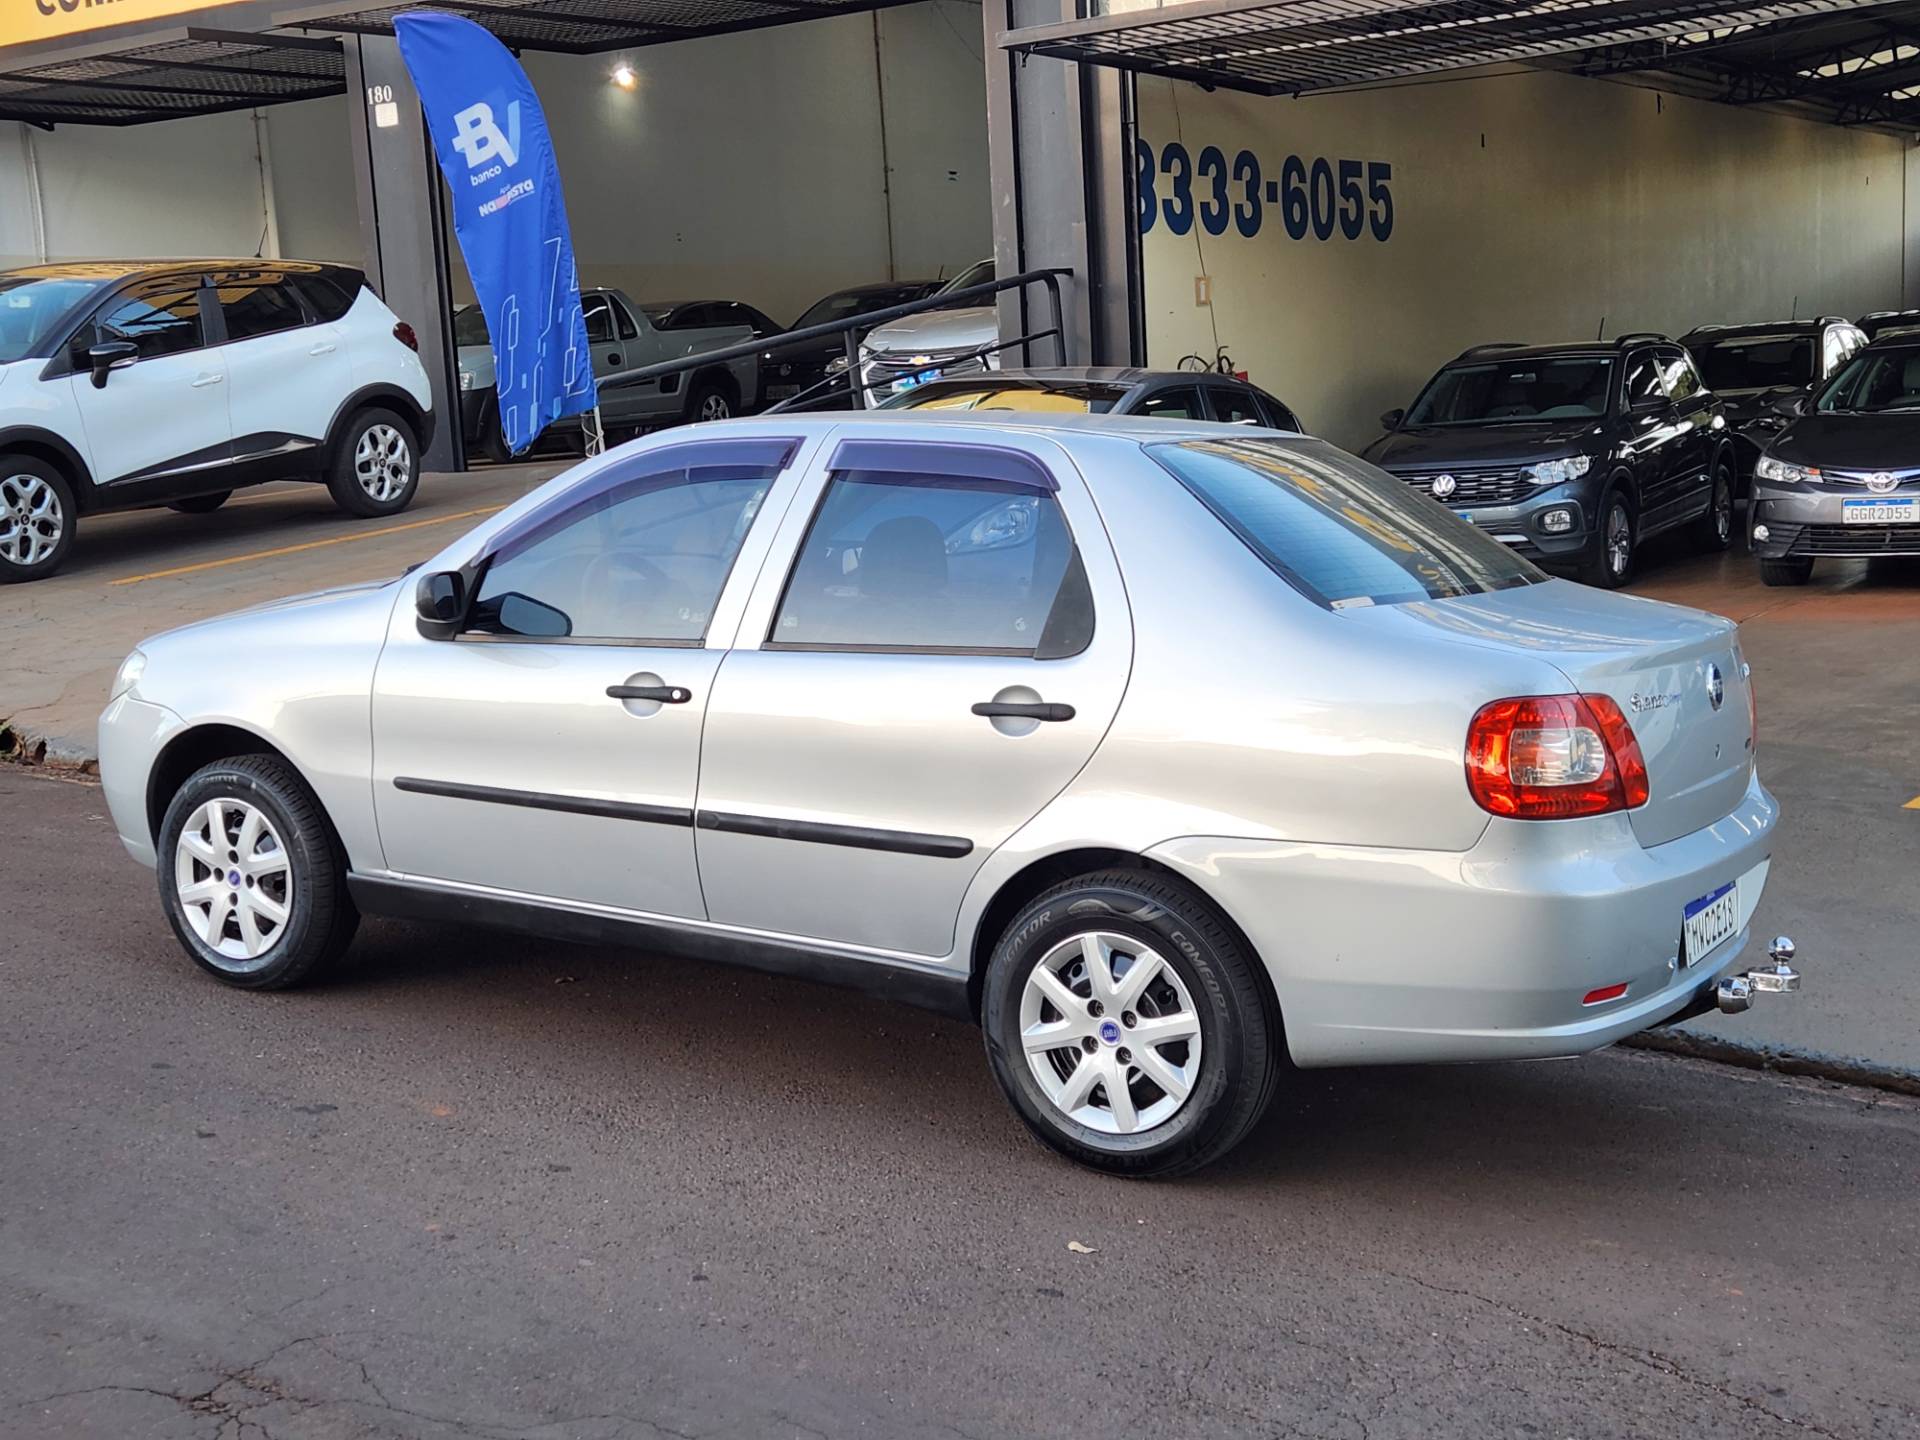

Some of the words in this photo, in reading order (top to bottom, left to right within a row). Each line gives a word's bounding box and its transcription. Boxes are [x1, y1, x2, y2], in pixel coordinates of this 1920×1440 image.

[367, 85, 392, 105] 180
[452, 99, 521, 169] BV
[470, 165, 502, 186] banco
[1851, 507, 1912, 520] GGR2D55
[1170, 931, 1231, 1023] COMFORT
